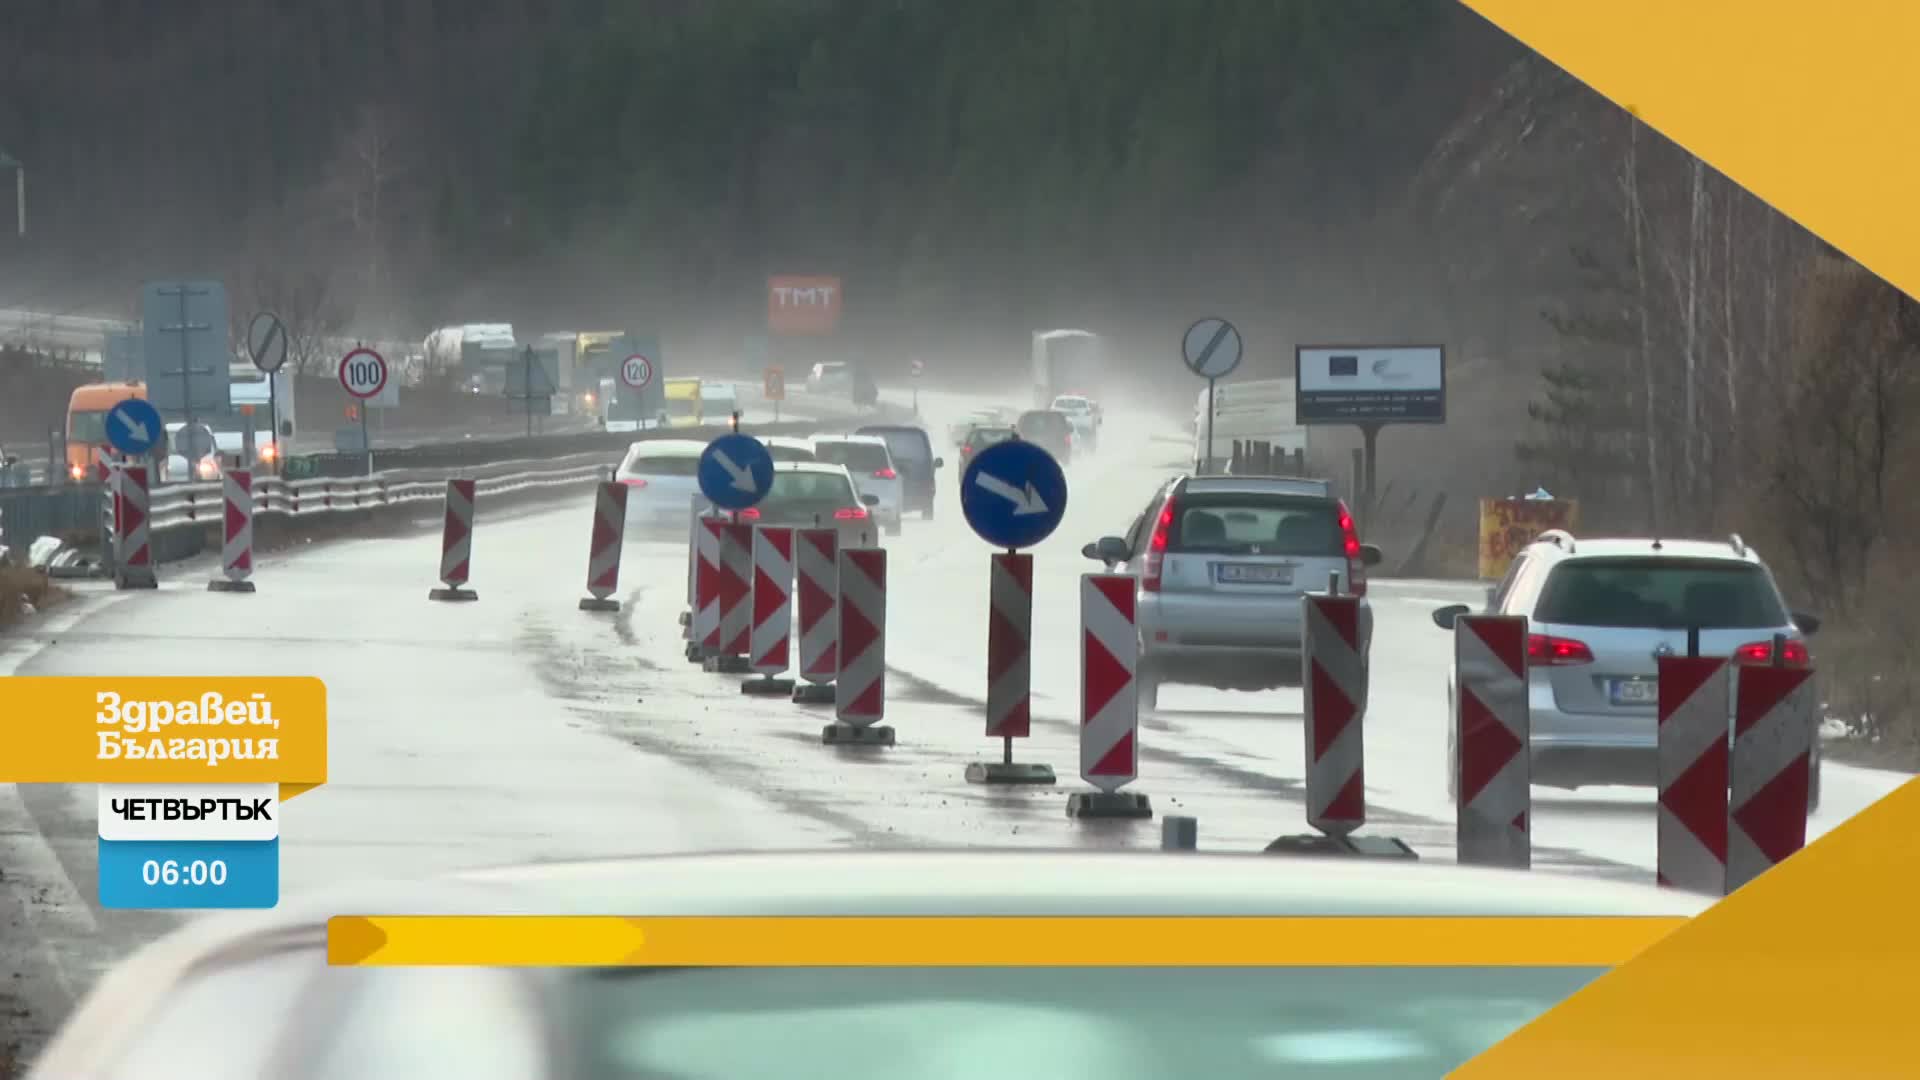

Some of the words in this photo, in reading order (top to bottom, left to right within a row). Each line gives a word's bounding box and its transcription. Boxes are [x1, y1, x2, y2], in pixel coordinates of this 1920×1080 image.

[772, 287, 835, 308] TMT
[348, 361, 380, 386] 100
[627, 362, 648, 380] 120
